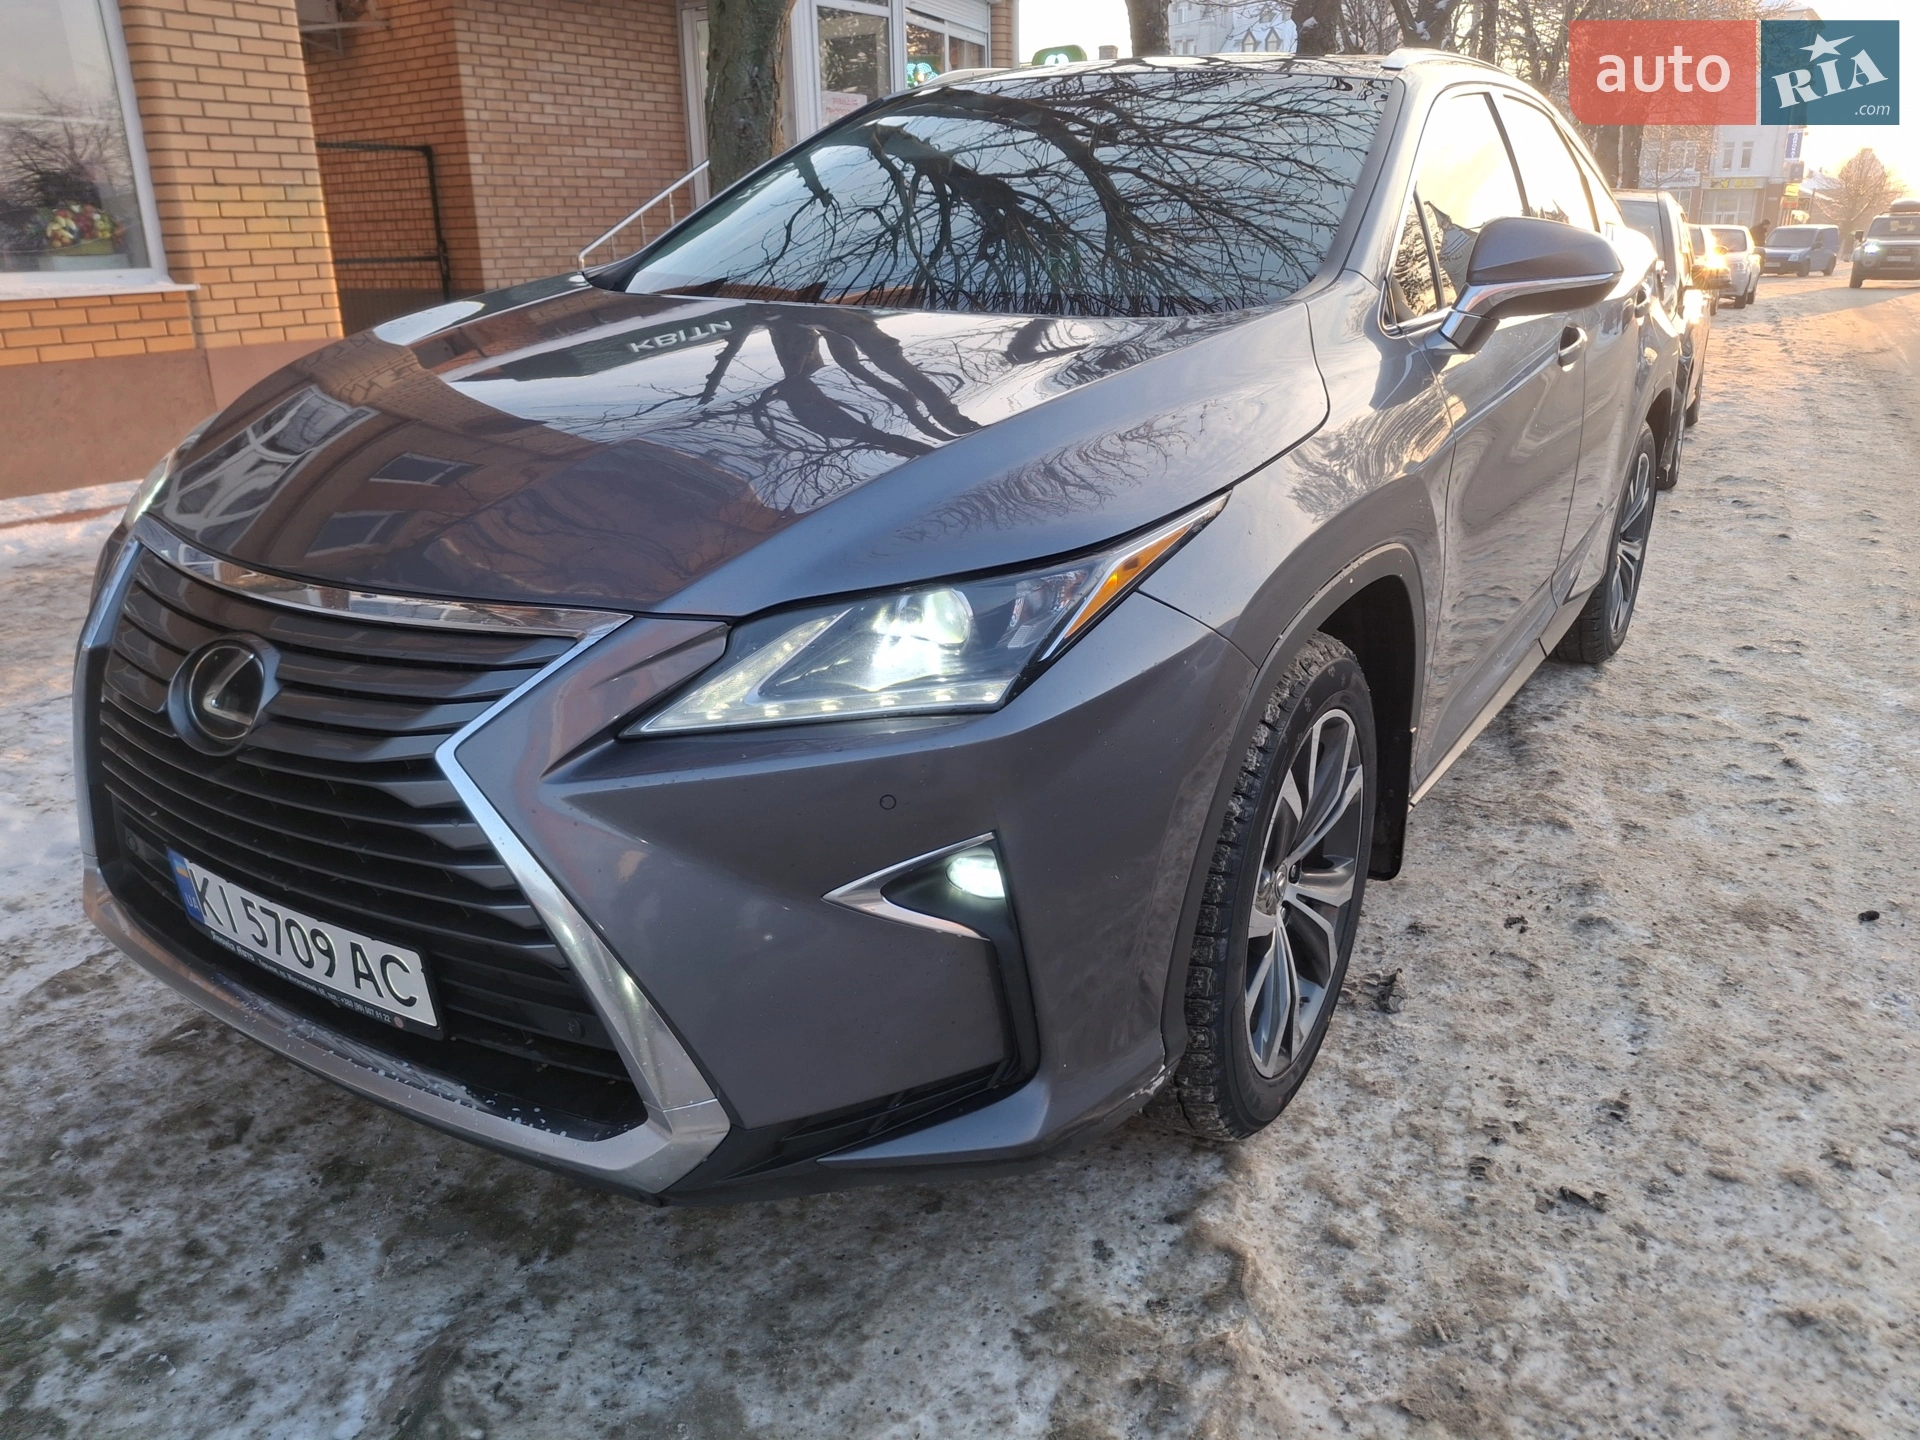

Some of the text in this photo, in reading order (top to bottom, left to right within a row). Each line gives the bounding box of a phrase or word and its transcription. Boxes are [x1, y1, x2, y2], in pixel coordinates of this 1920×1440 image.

[184, 892, 200, 912] UA
[240, 896, 338, 978] 5709
[350, 942, 418, 1008] AC
